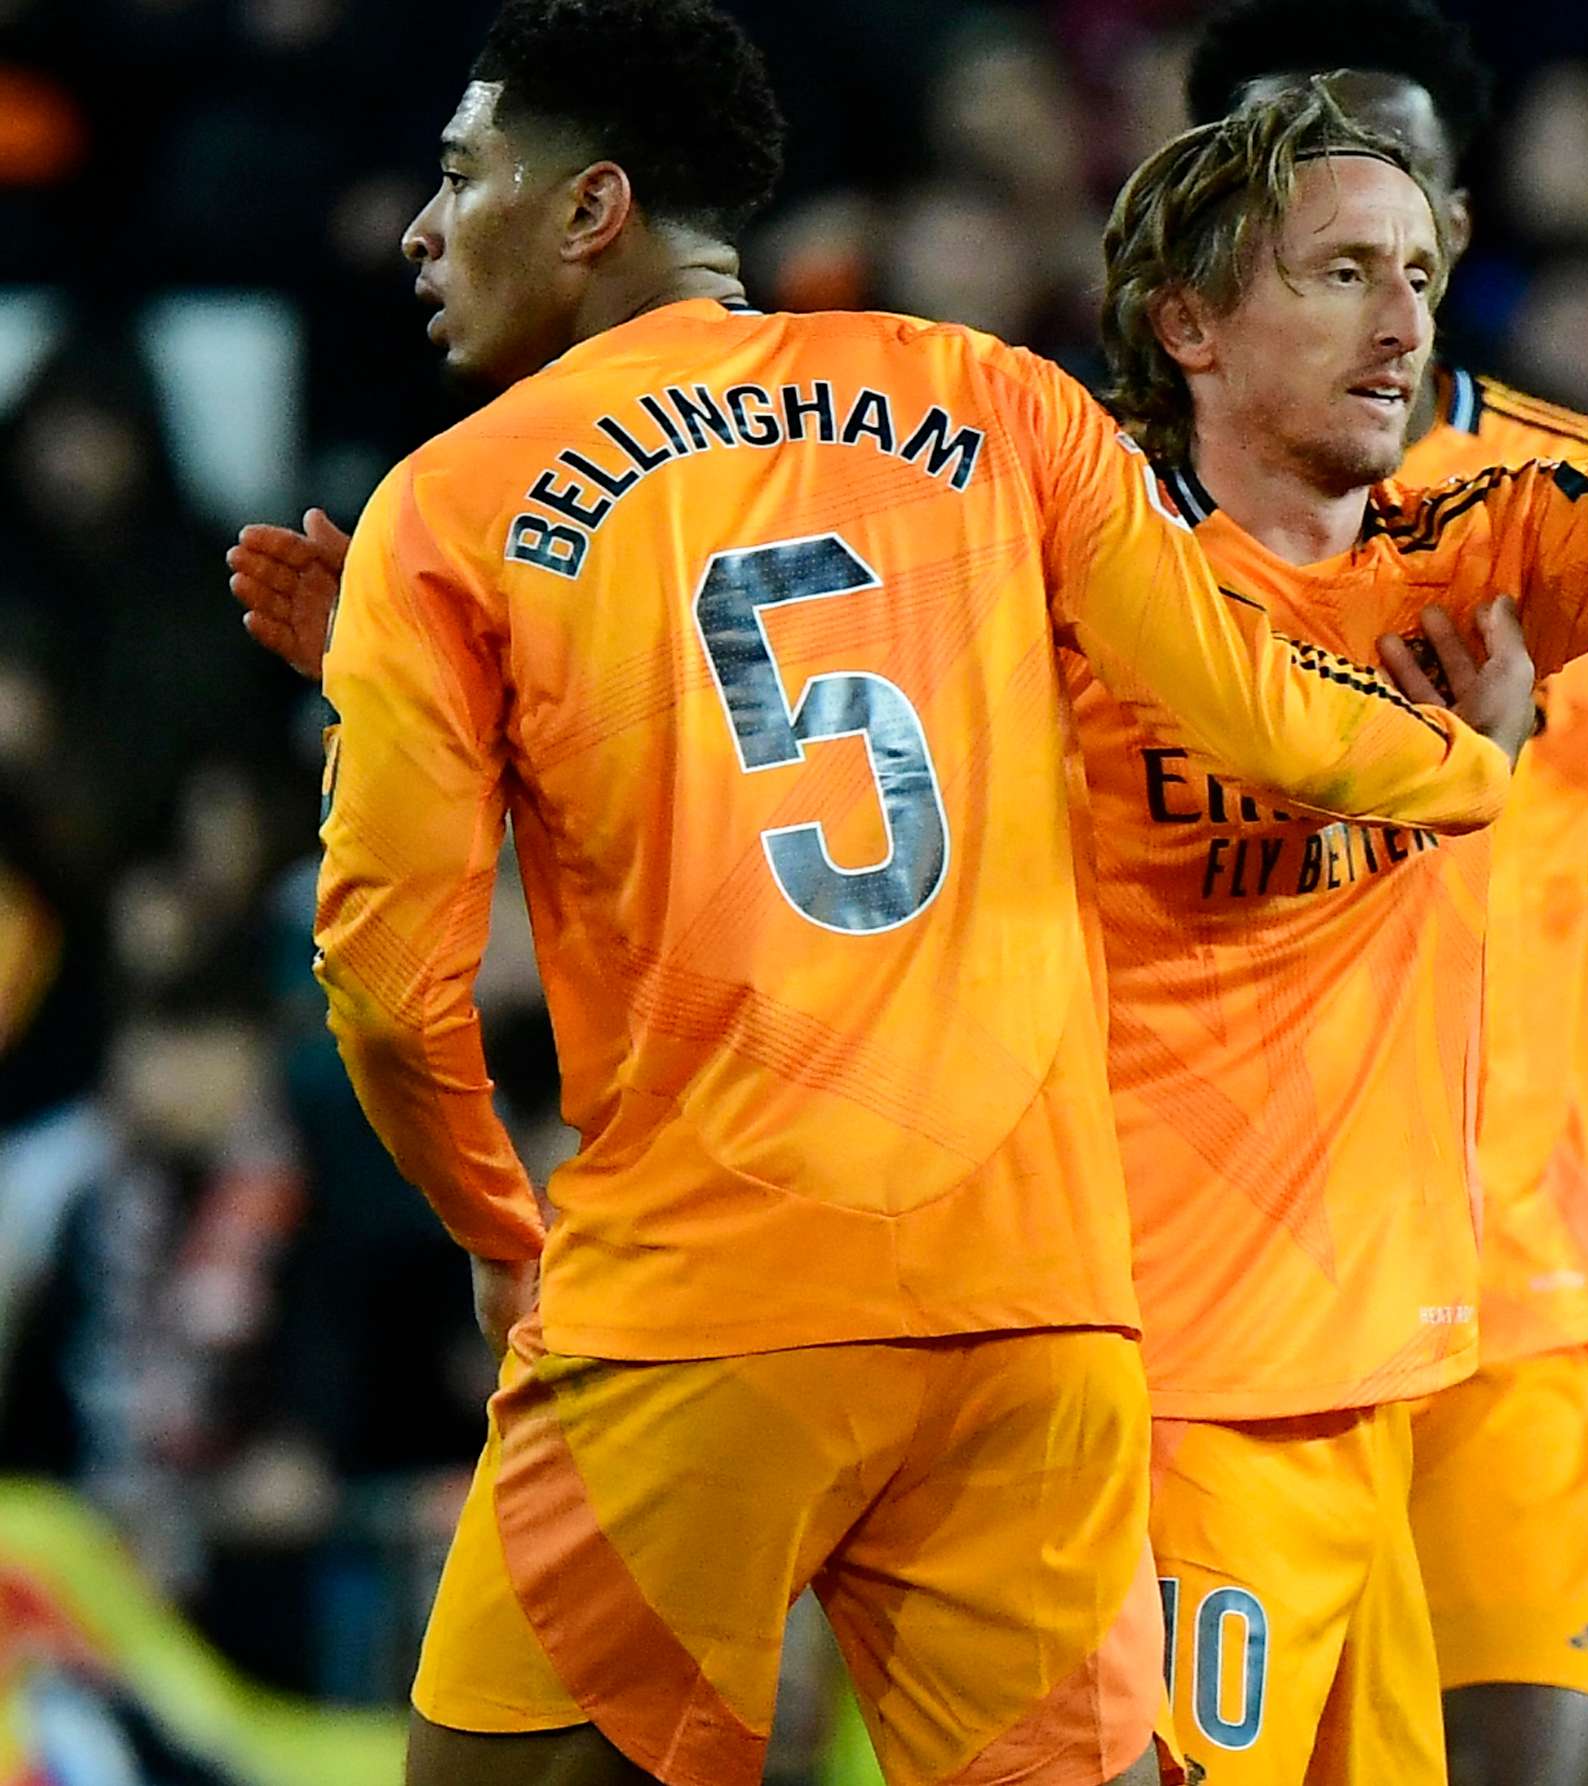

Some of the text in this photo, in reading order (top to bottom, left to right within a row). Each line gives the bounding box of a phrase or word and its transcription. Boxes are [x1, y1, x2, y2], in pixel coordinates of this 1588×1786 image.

[504, 380, 986, 580] BELLINGHAM
[692, 531, 951, 936] 5
[1202, 837, 1284, 899] FLY
